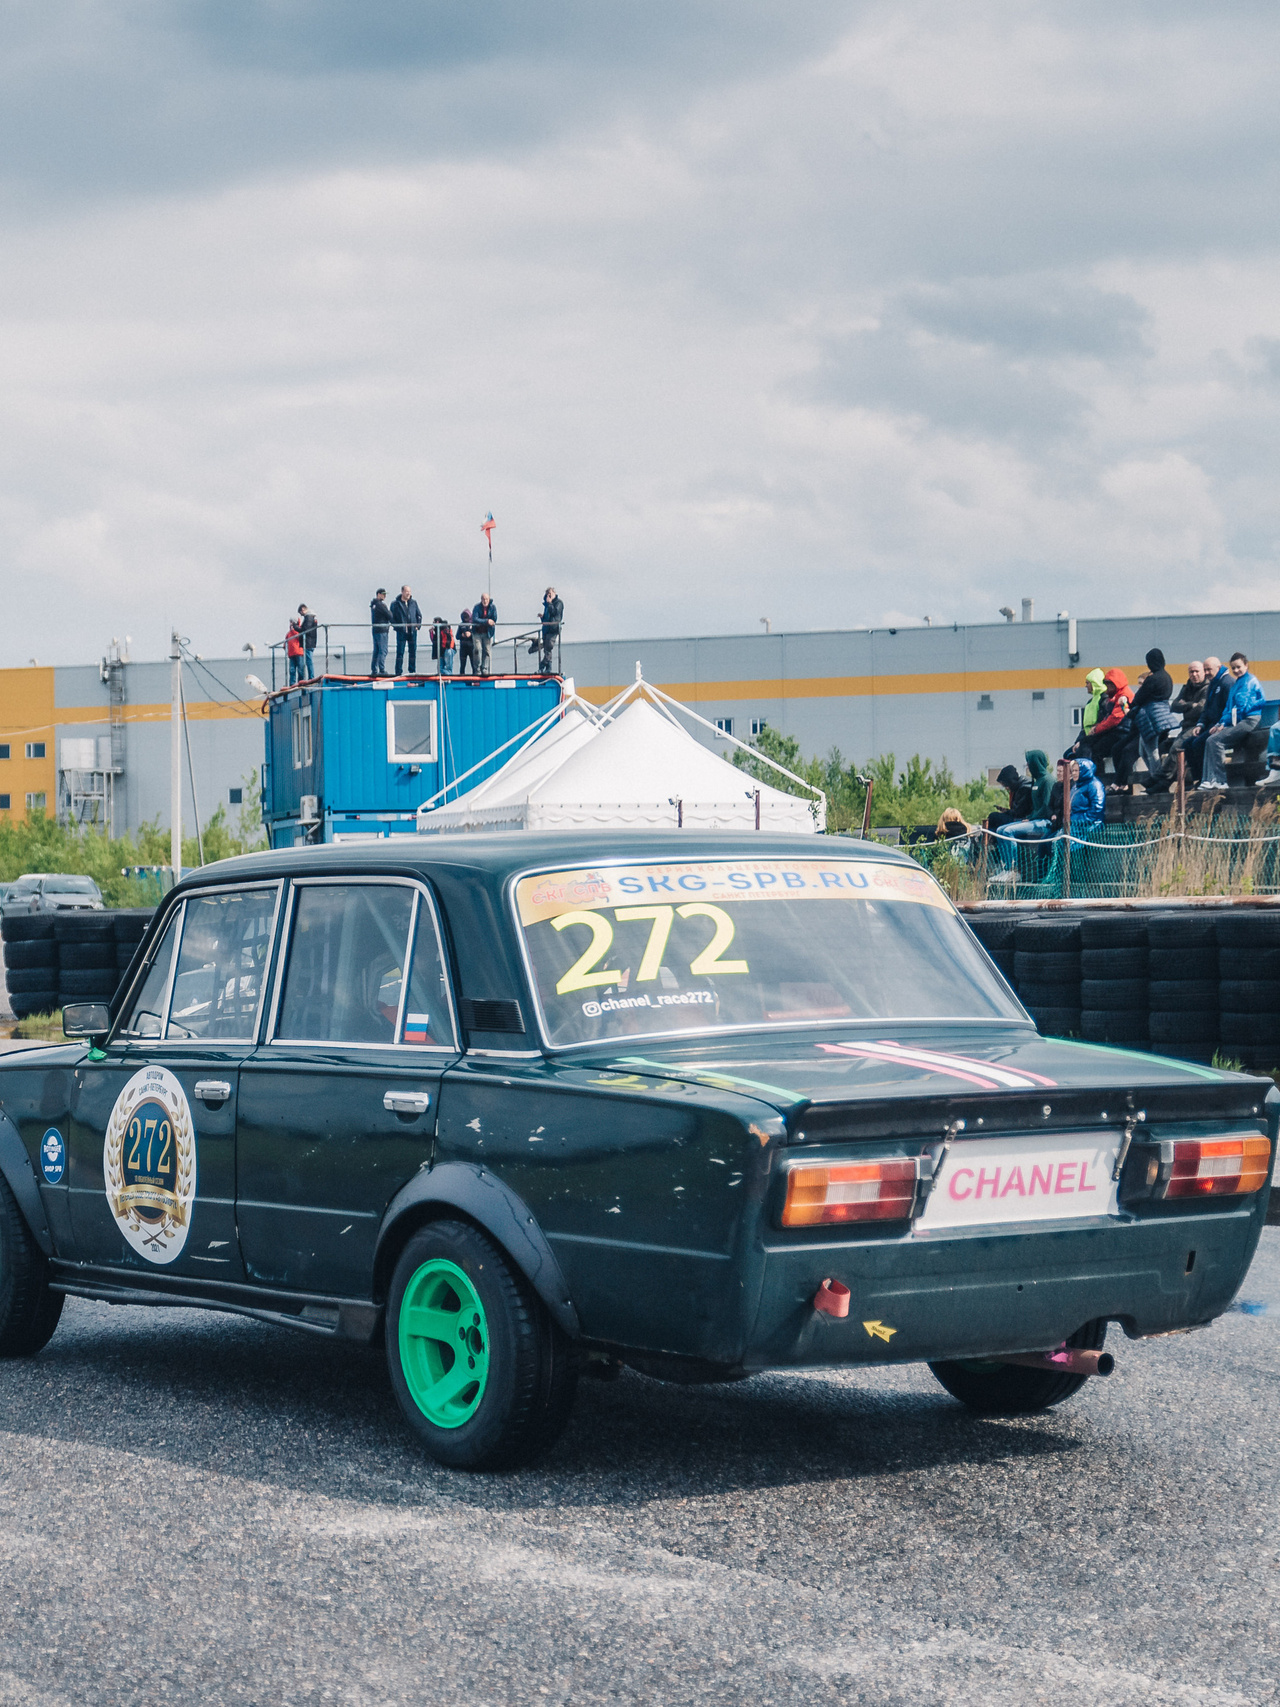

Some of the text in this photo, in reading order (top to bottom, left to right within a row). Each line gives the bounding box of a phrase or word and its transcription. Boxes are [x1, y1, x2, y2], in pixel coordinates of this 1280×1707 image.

[531, 881, 612, 905] СКГ СПБ
[618, 871, 869, 894] SKG-SPB.RU
[549, 902, 750, 995] 272
[128, 1118, 171, 1173] 272
[948, 1161, 1097, 1201] CHANEL
